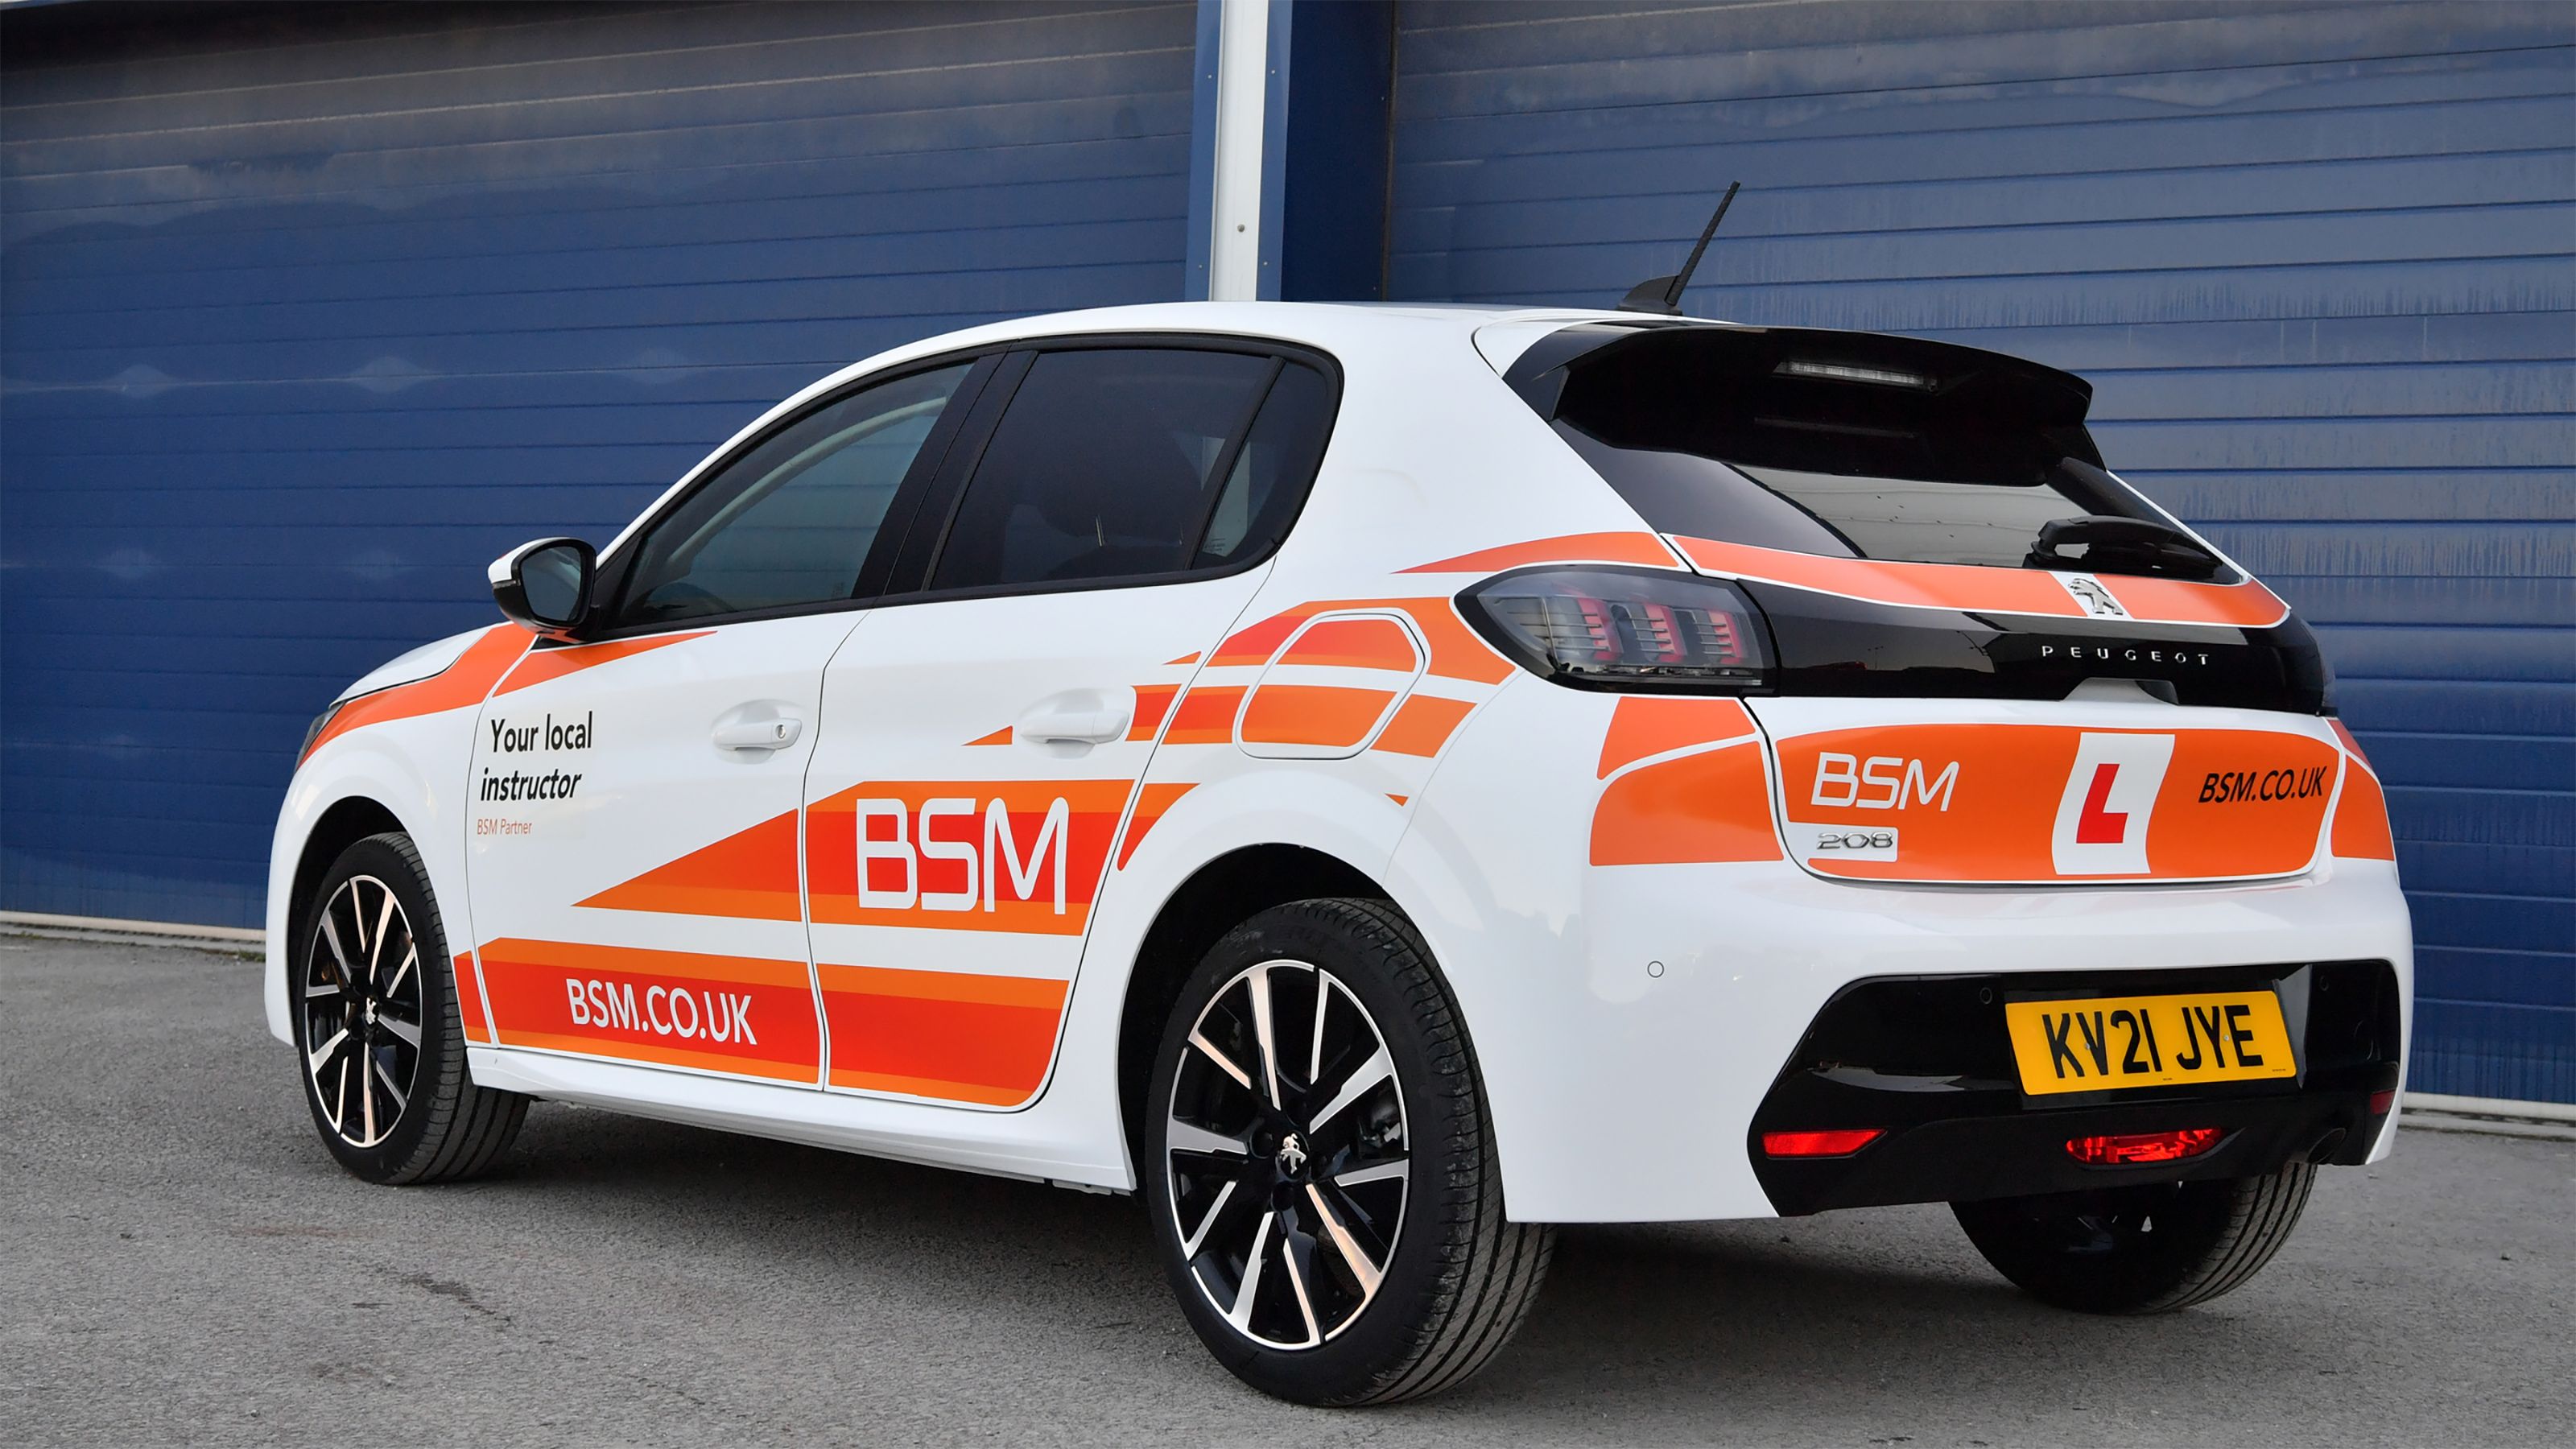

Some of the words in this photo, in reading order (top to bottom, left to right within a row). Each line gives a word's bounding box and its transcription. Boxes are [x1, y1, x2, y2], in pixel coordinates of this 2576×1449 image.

[2041, 646, 2209, 665] PEUGEOT
[491, 718, 539, 753] Your
[545, 710, 592, 750] local
[481, 766, 582, 801] instructor
[1810, 751, 1959, 811] BSM
[2198, 766, 2327, 803] BSM.CO.UK
[2075, 763, 2128, 844] L
[477, 819, 497, 835] BSM
[500, 818, 532, 834] Partner
[1817, 833, 1893, 850] 208
[857, 797, 1069, 914] BSM
[566, 978, 758, 1045] BSM.CO.UK
[2041, 1009, 2163, 1079] KV21
[2176, 1004, 2264, 1071] JYE
